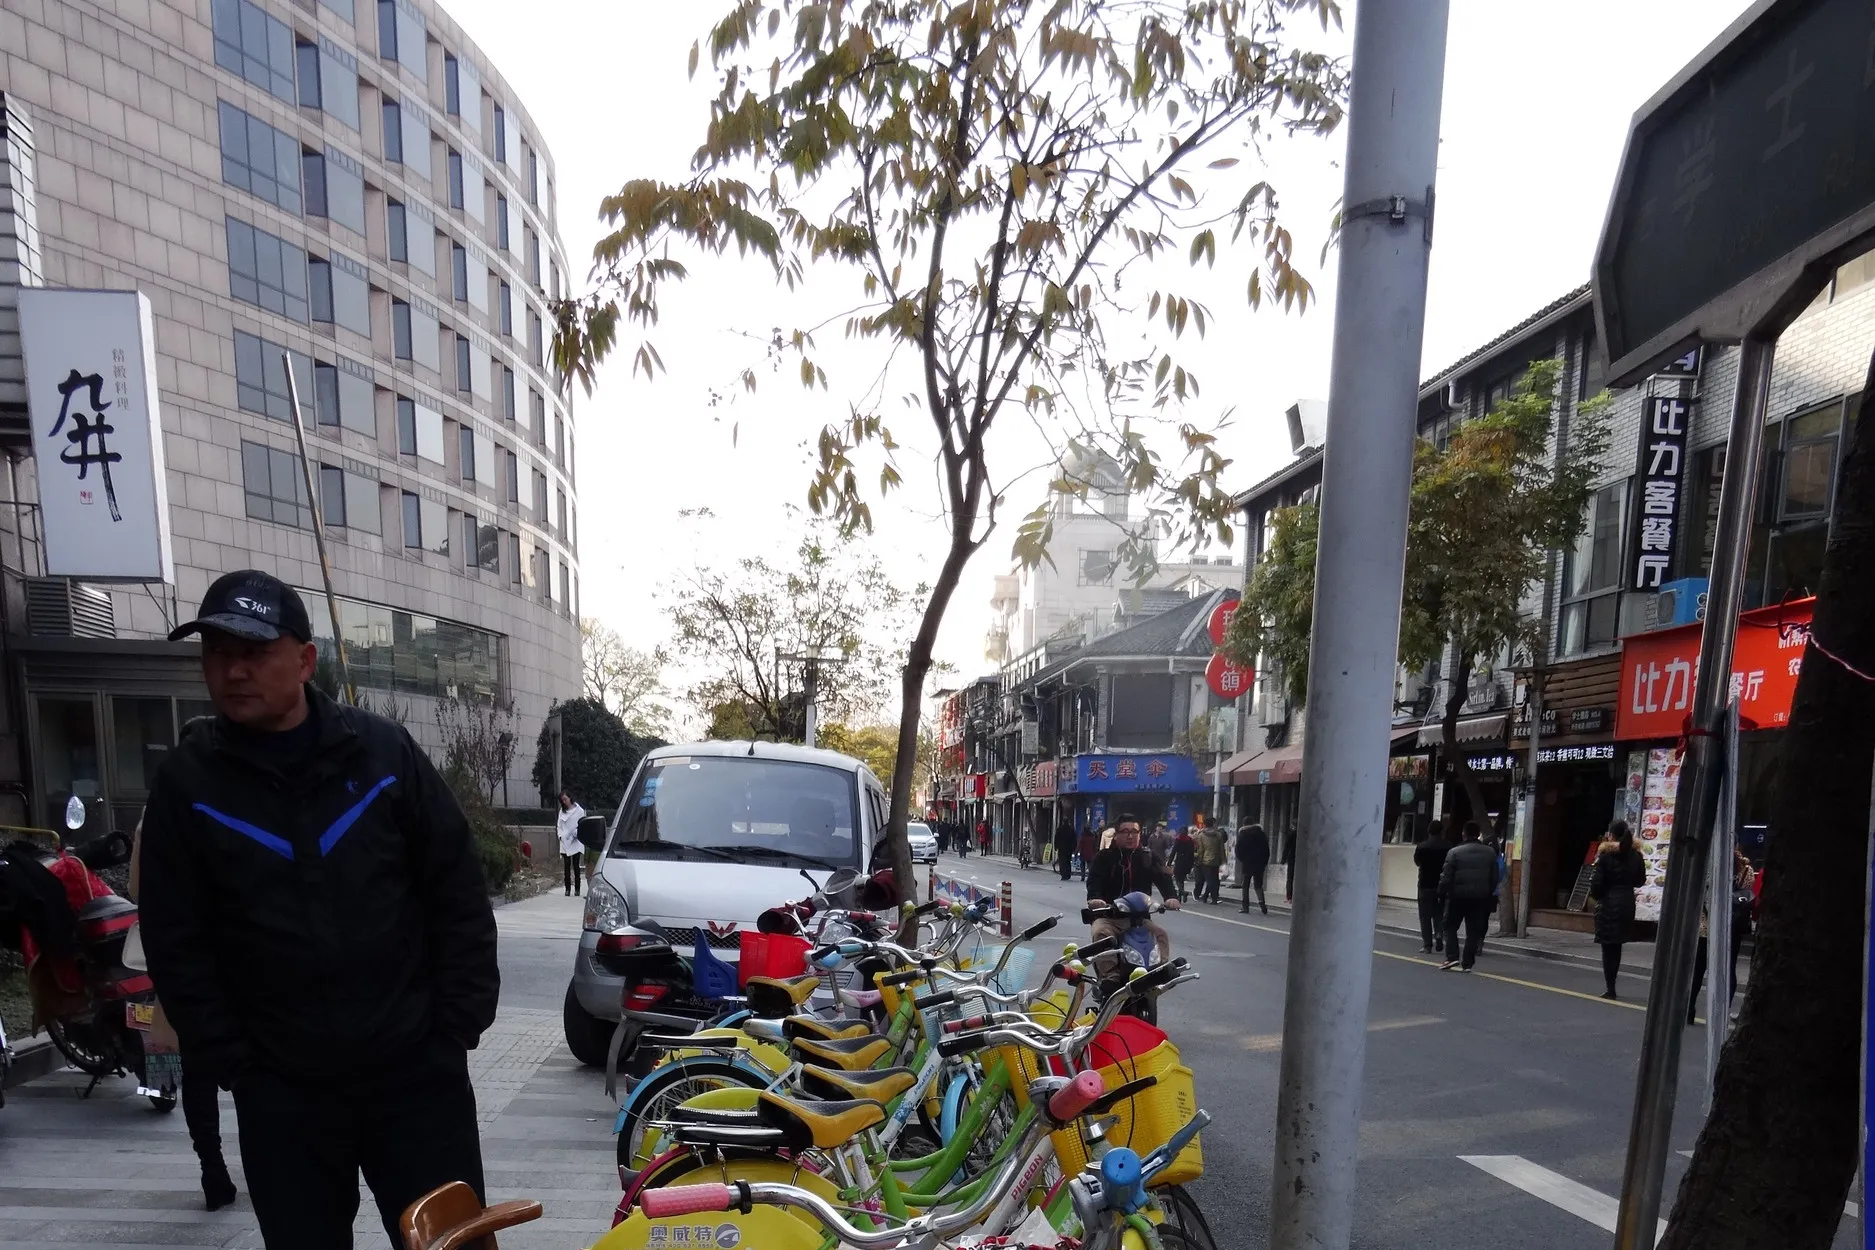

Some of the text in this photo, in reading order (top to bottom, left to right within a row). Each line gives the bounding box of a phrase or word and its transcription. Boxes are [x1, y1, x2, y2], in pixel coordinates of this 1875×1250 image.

[1637, 400, 1684, 588] 比力客餐厅
[1632, 656, 1764, 714] 比力餐厅
[1087, 759, 1168, 780] 天堂伞
[650, 1225, 713, 1242] 奥威特
